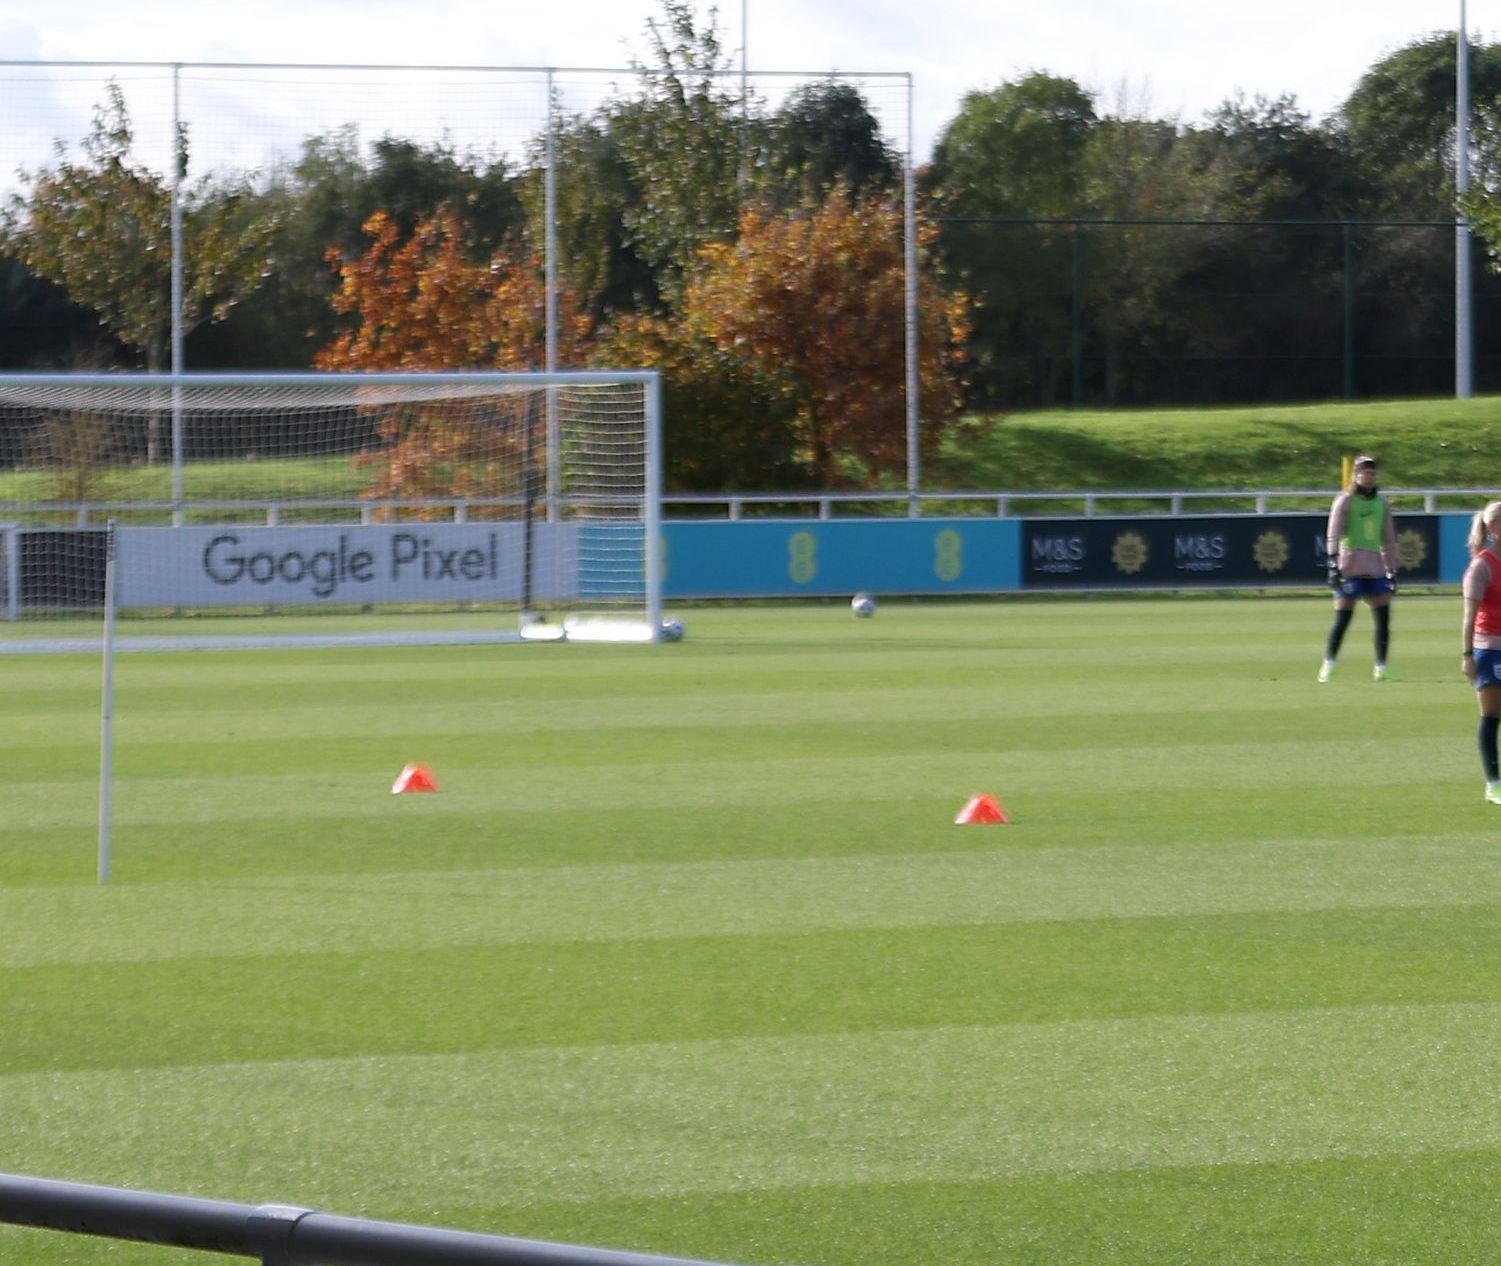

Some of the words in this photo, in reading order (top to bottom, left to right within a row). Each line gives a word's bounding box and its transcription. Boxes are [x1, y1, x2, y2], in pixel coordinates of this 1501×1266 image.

[1032, 537, 1084, 561] M&S
[1174, 536, 1225, 559] M&S
[204, 534, 374, 598] Google
[390, 531, 498, 580] Pixel
